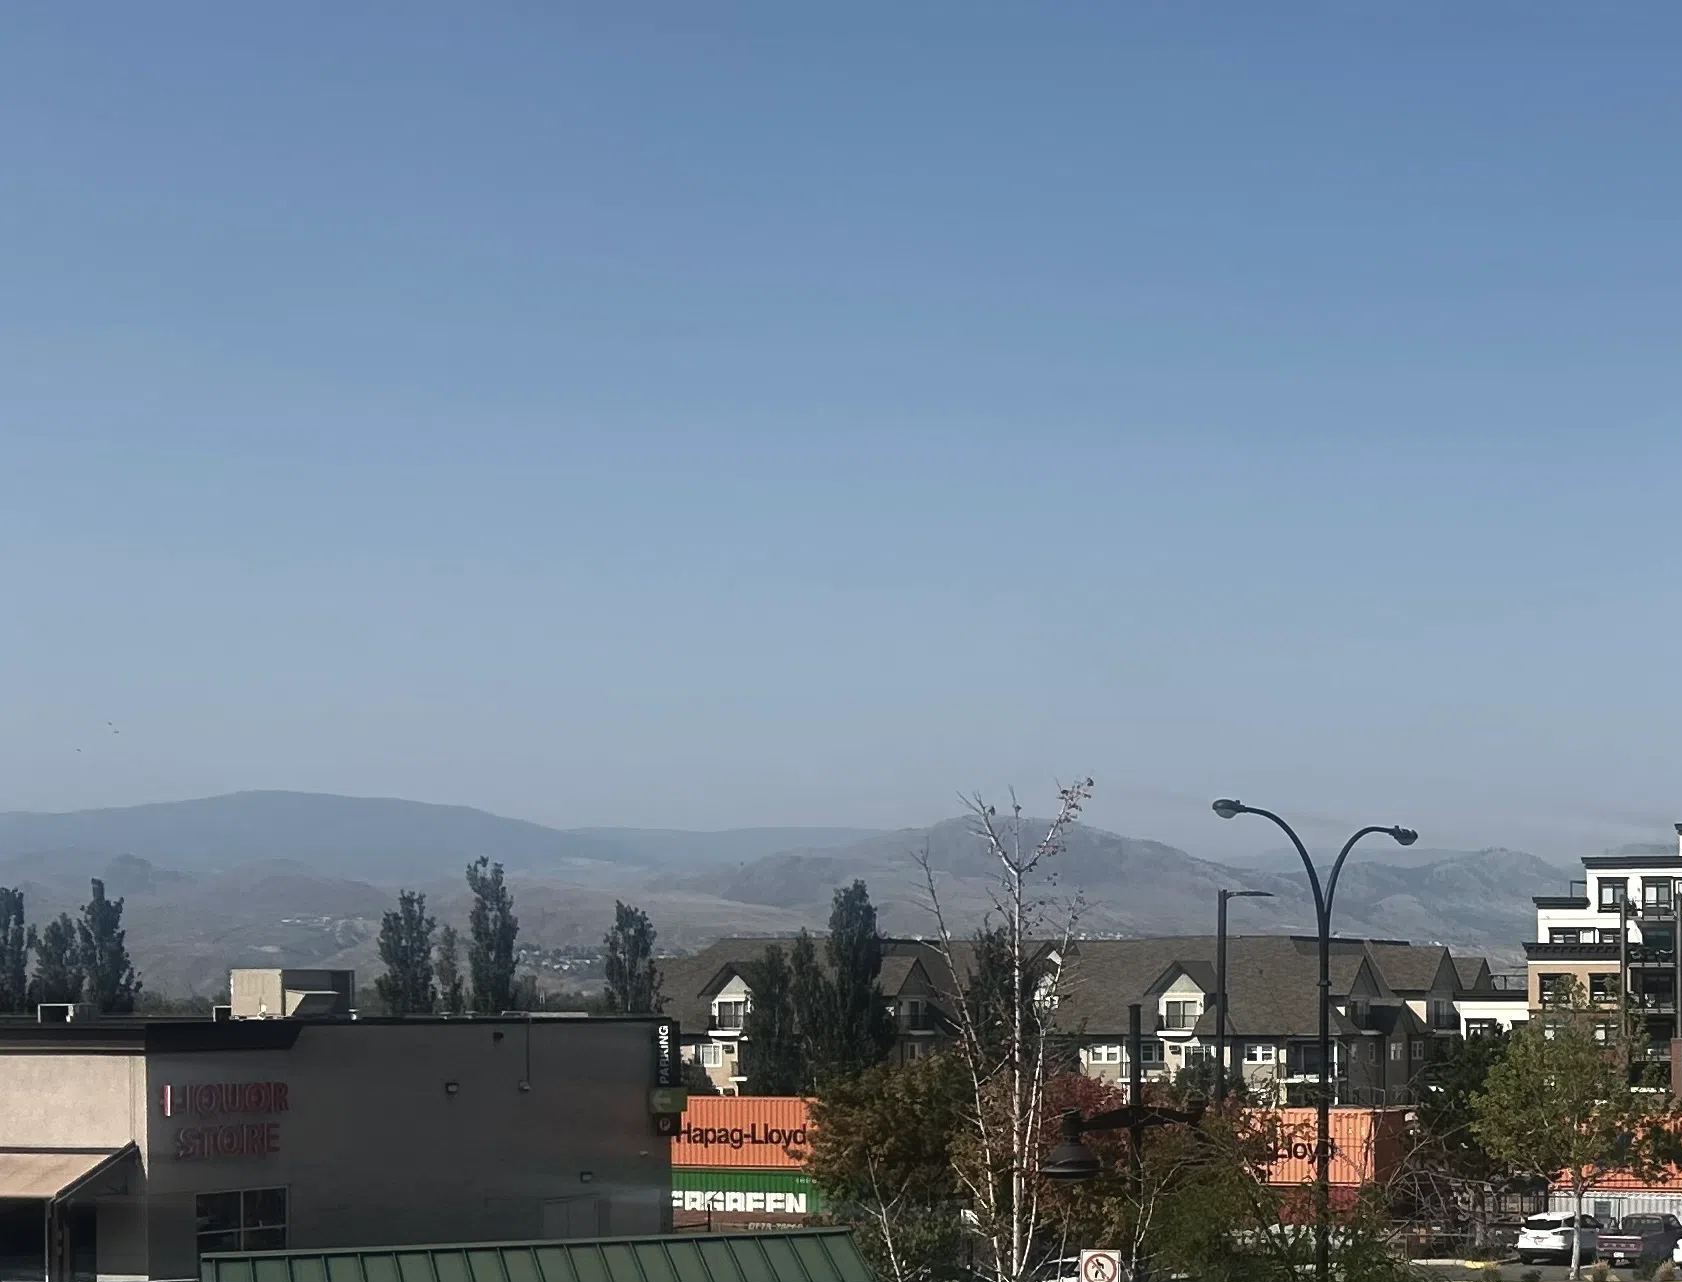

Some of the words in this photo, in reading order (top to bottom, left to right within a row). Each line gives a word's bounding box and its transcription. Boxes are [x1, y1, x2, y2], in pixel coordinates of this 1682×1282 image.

[658, 1025, 670, 1084] PARKING
[162, 1082, 289, 1117] LIQUOR
[176, 1123, 281, 1160] STORE
[676, 1123, 807, 1148] Hapag-Lloyd
